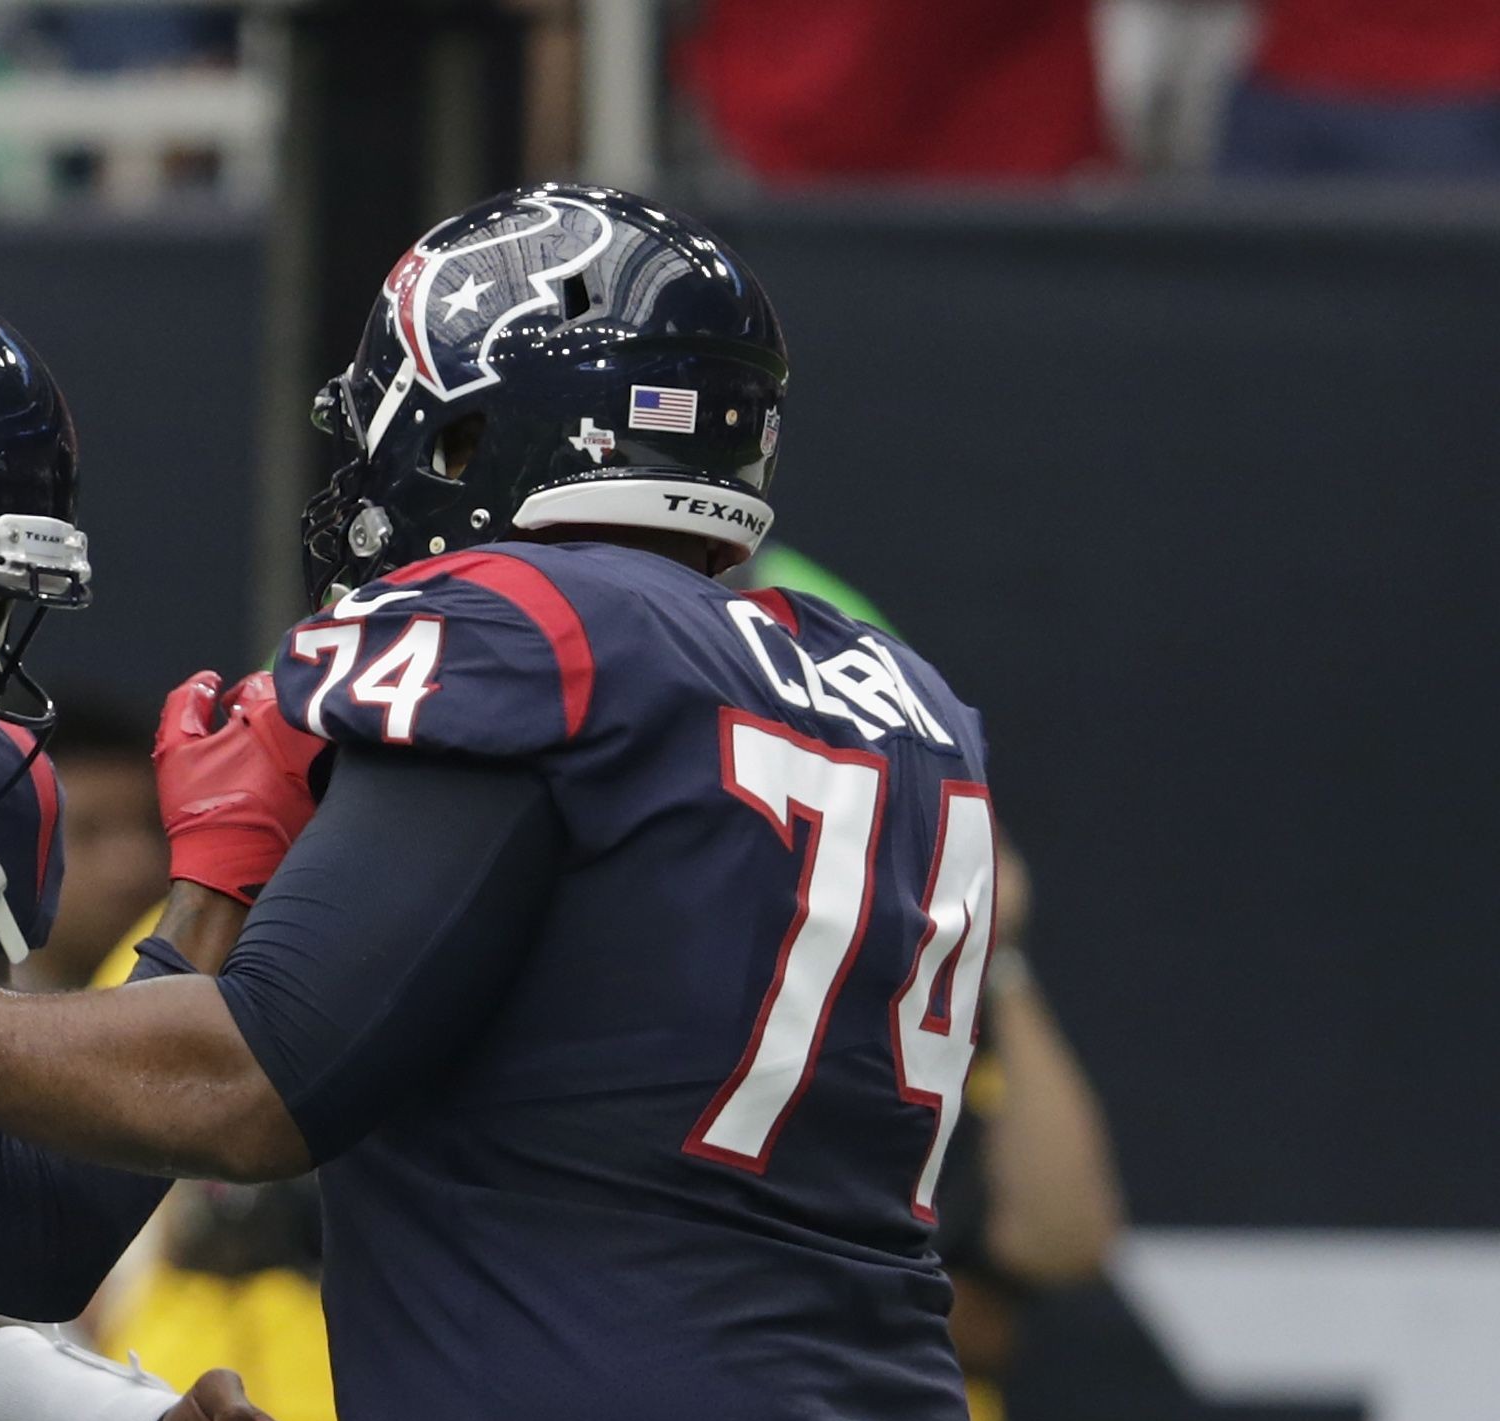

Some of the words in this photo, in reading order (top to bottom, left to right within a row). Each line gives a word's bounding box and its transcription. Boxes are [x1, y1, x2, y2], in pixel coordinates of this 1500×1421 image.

[663, 493, 766, 537] TEXANS
[291, 614, 445, 744] 74
[727, 600, 954, 746] CLRK
[682, 706, 997, 1224] 74
